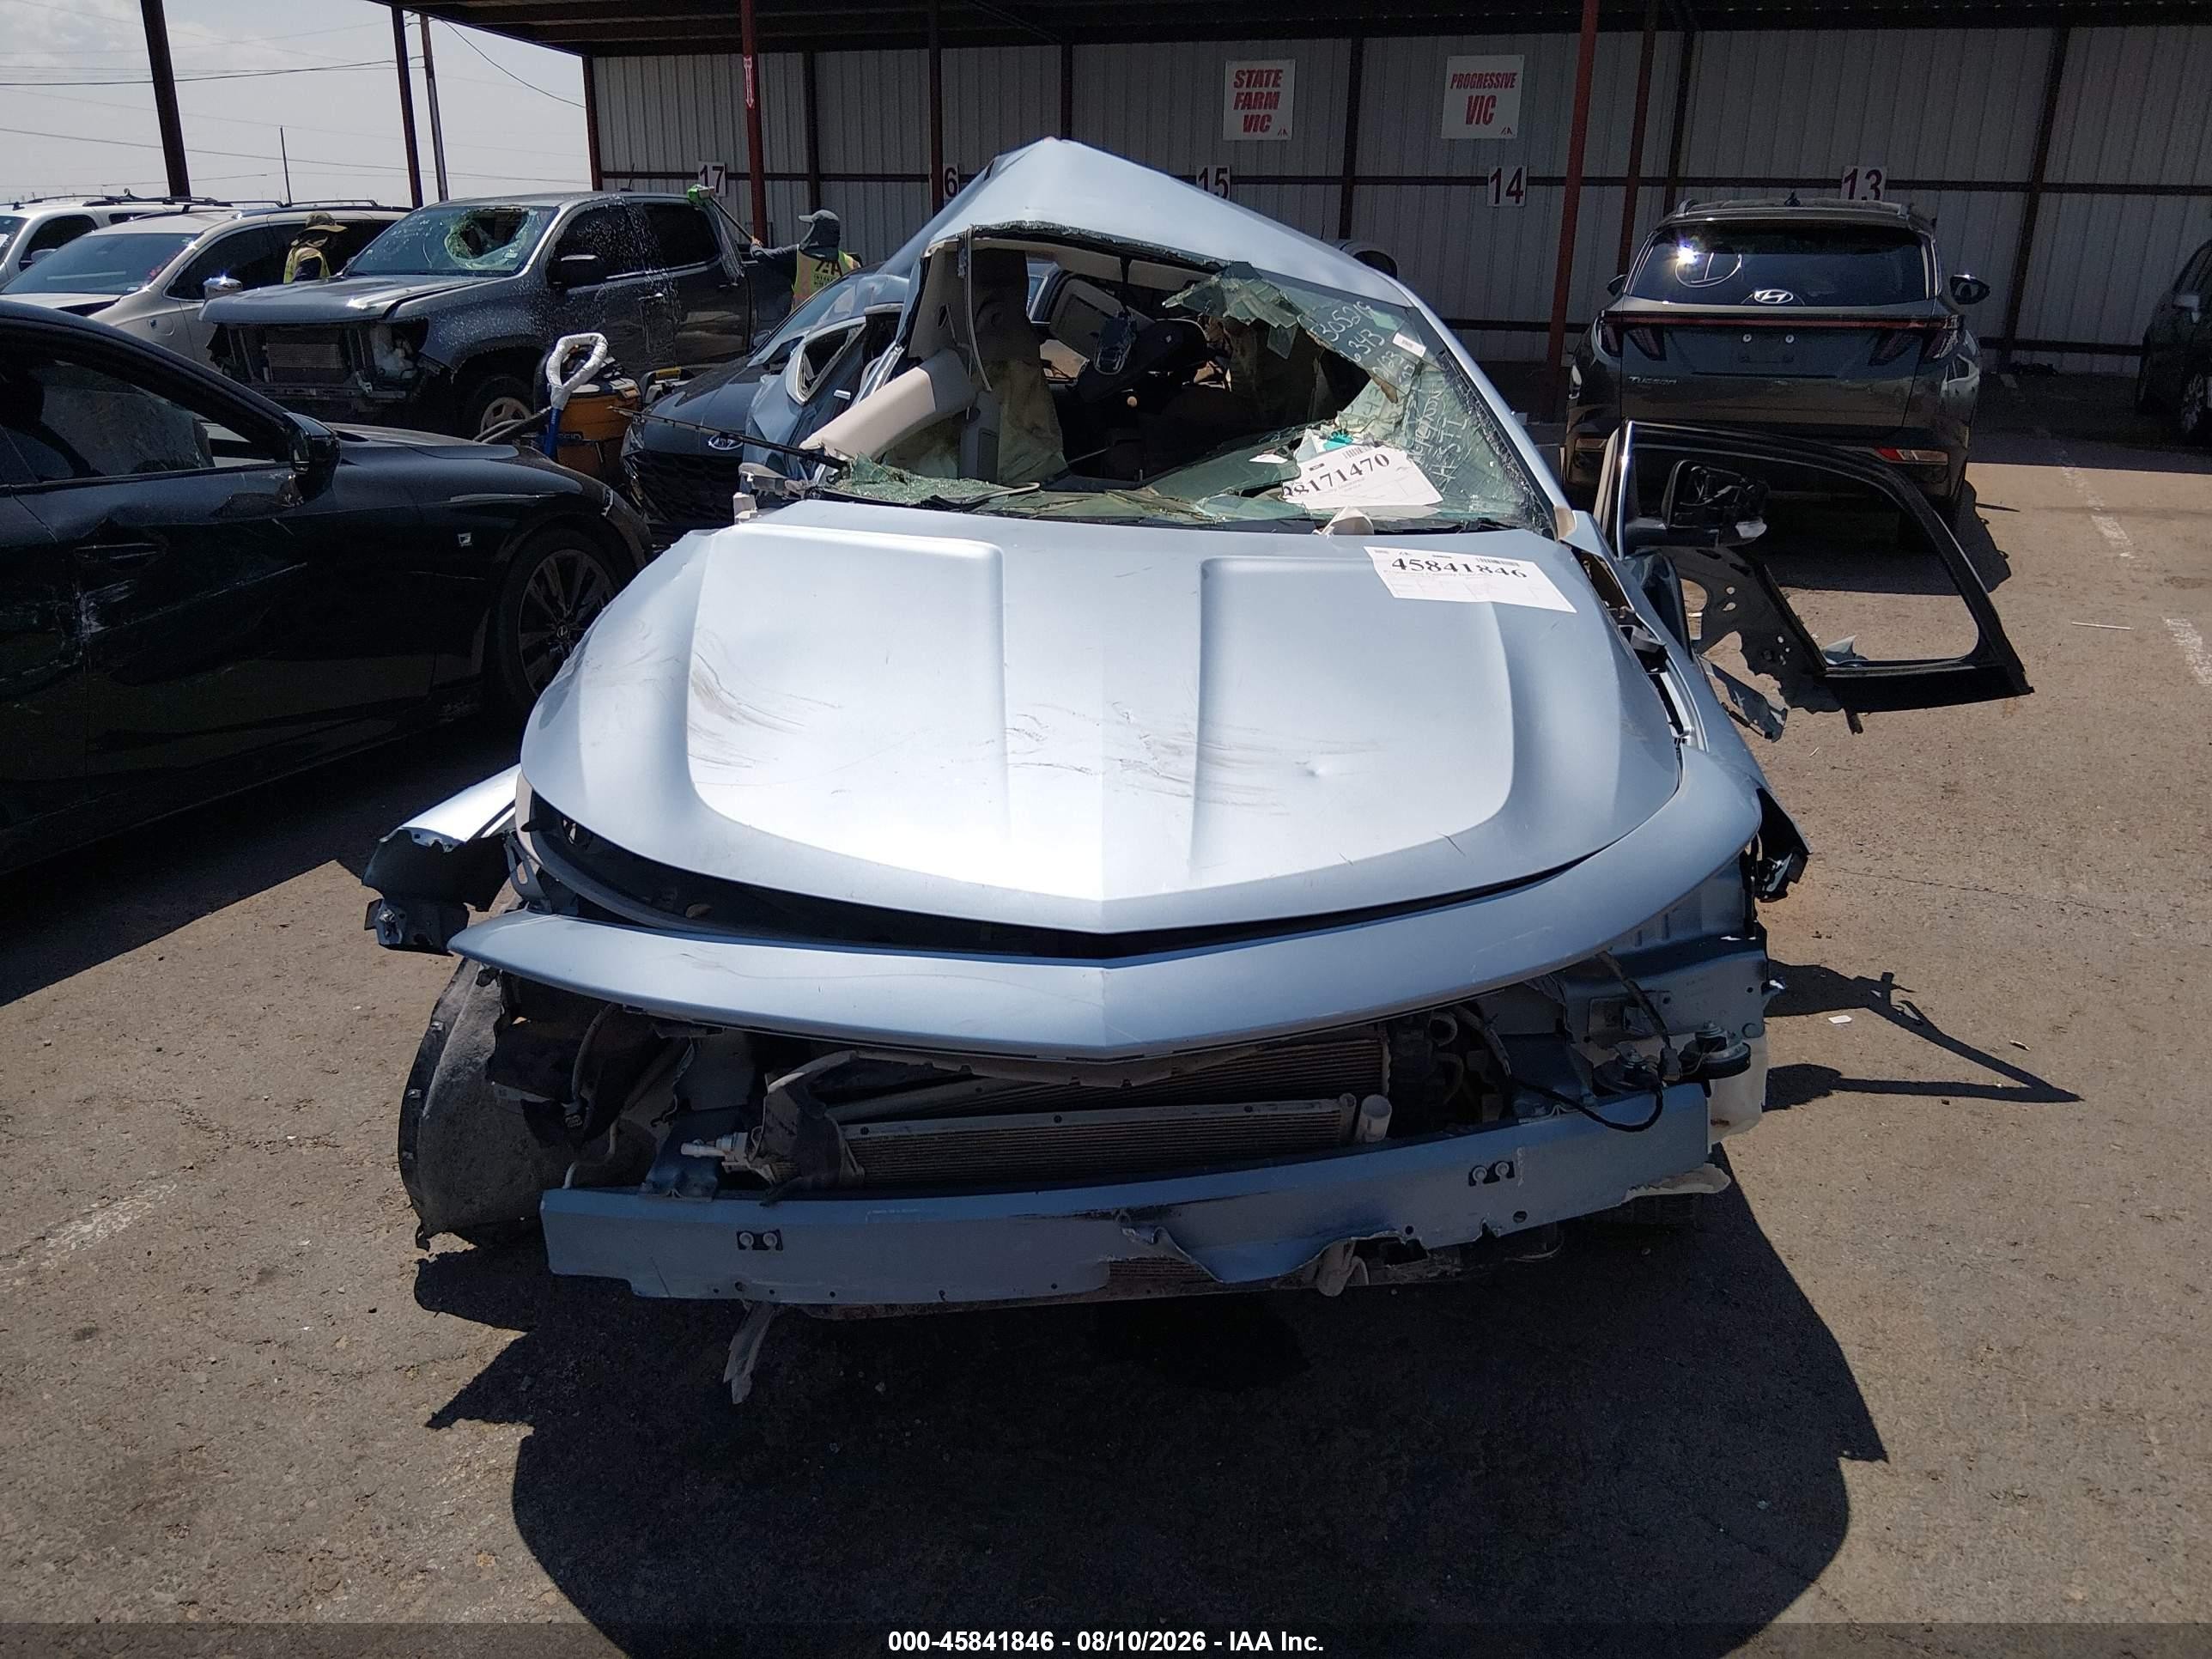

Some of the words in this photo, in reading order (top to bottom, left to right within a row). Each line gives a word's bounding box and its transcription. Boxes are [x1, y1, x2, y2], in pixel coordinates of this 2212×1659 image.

[1233, 70, 1283, 88] STATE
[1449, 72, 1518, 89] PROGRESSIVE
[1233, 92, 1280, 110] FARM
[1466, 94, 1498, 125] VIC
[1243, 113, 1273, 133] VIC
[700, 164, 725, 194] 17
[944, 167, 958, 198] 6
[1198, 167, 1229, 199] 15
[1490, 167, 1524, 204] 14
[1844, 168, 1883, 201] 13
[1391, 557, 1528, 579] 45841846
